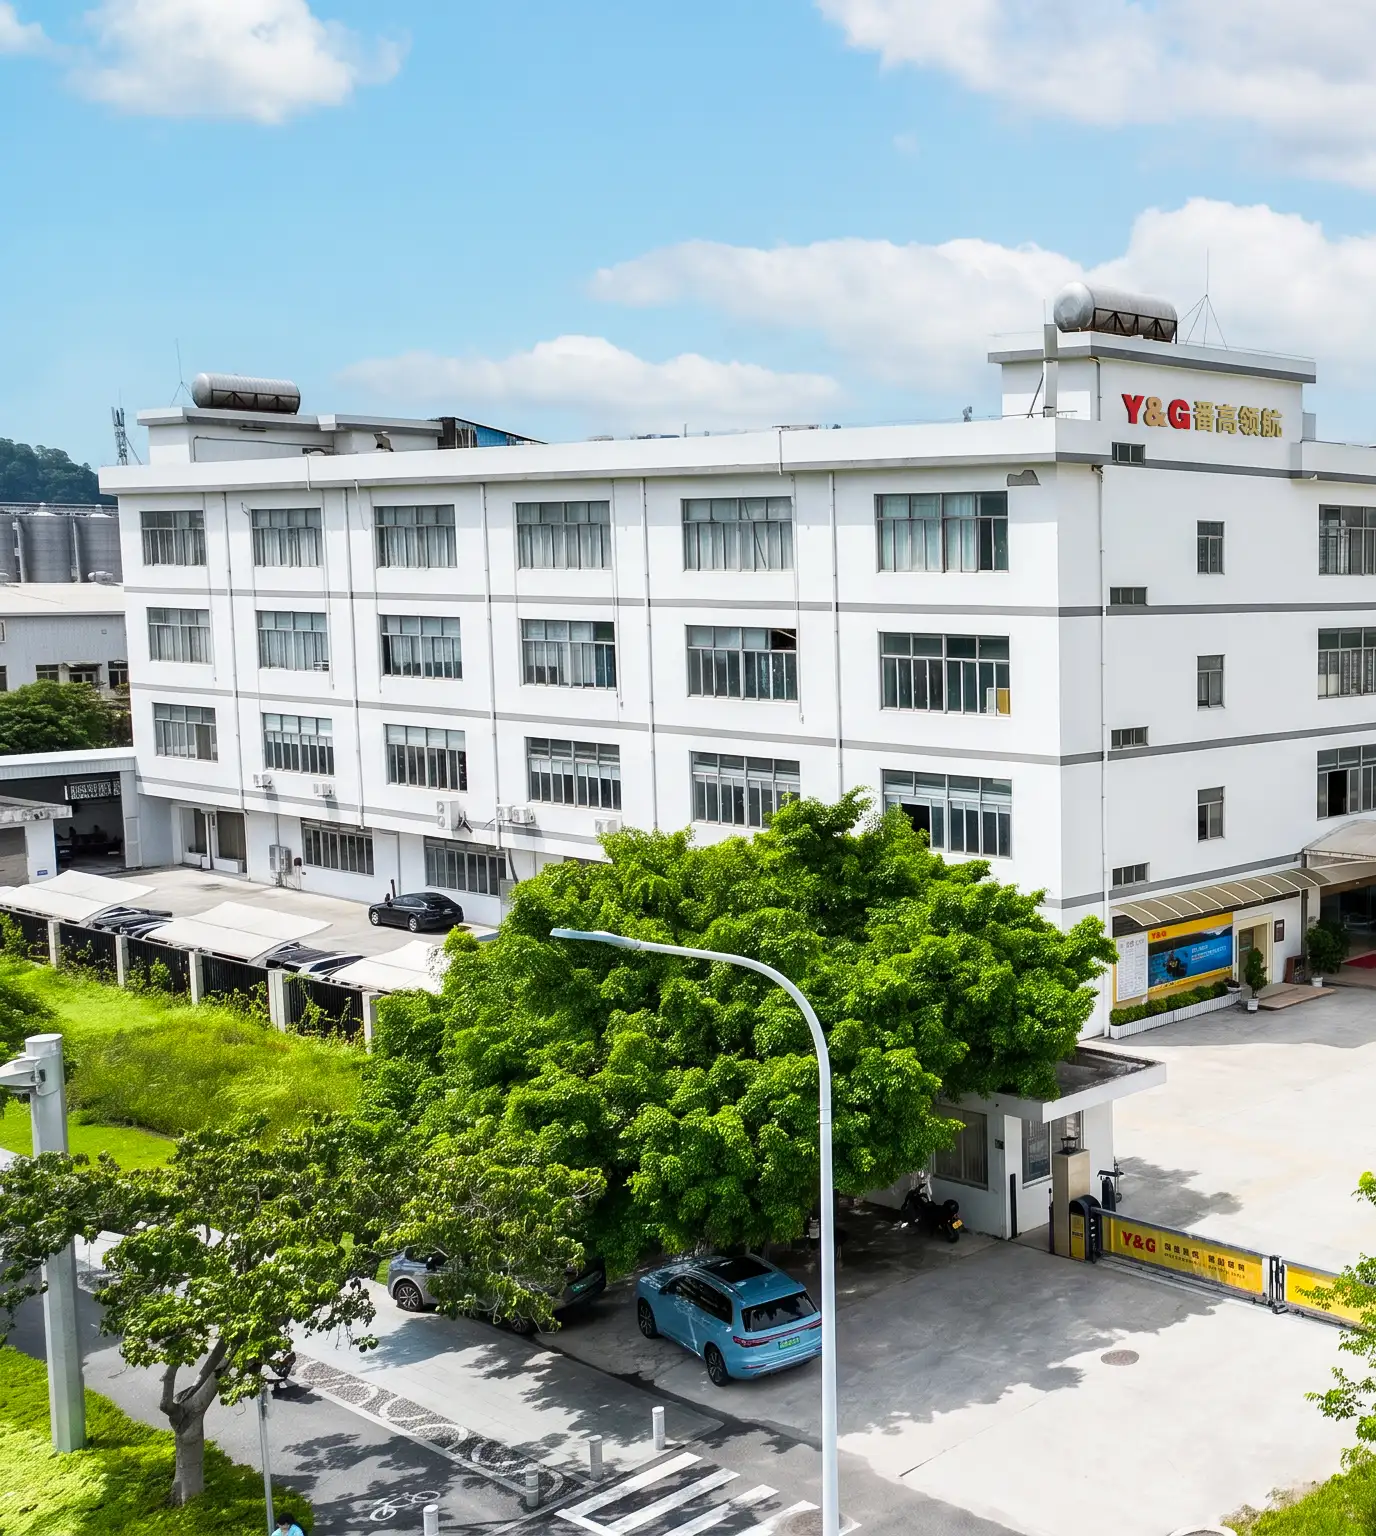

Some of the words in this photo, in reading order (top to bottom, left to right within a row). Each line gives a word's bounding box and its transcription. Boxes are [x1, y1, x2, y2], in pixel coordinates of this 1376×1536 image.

[1121, 394, 1190, 430] Y&G
[1193, 401, 1282, 437] 番高领航
[1122, 1231, 1156, 1253] Y&G
